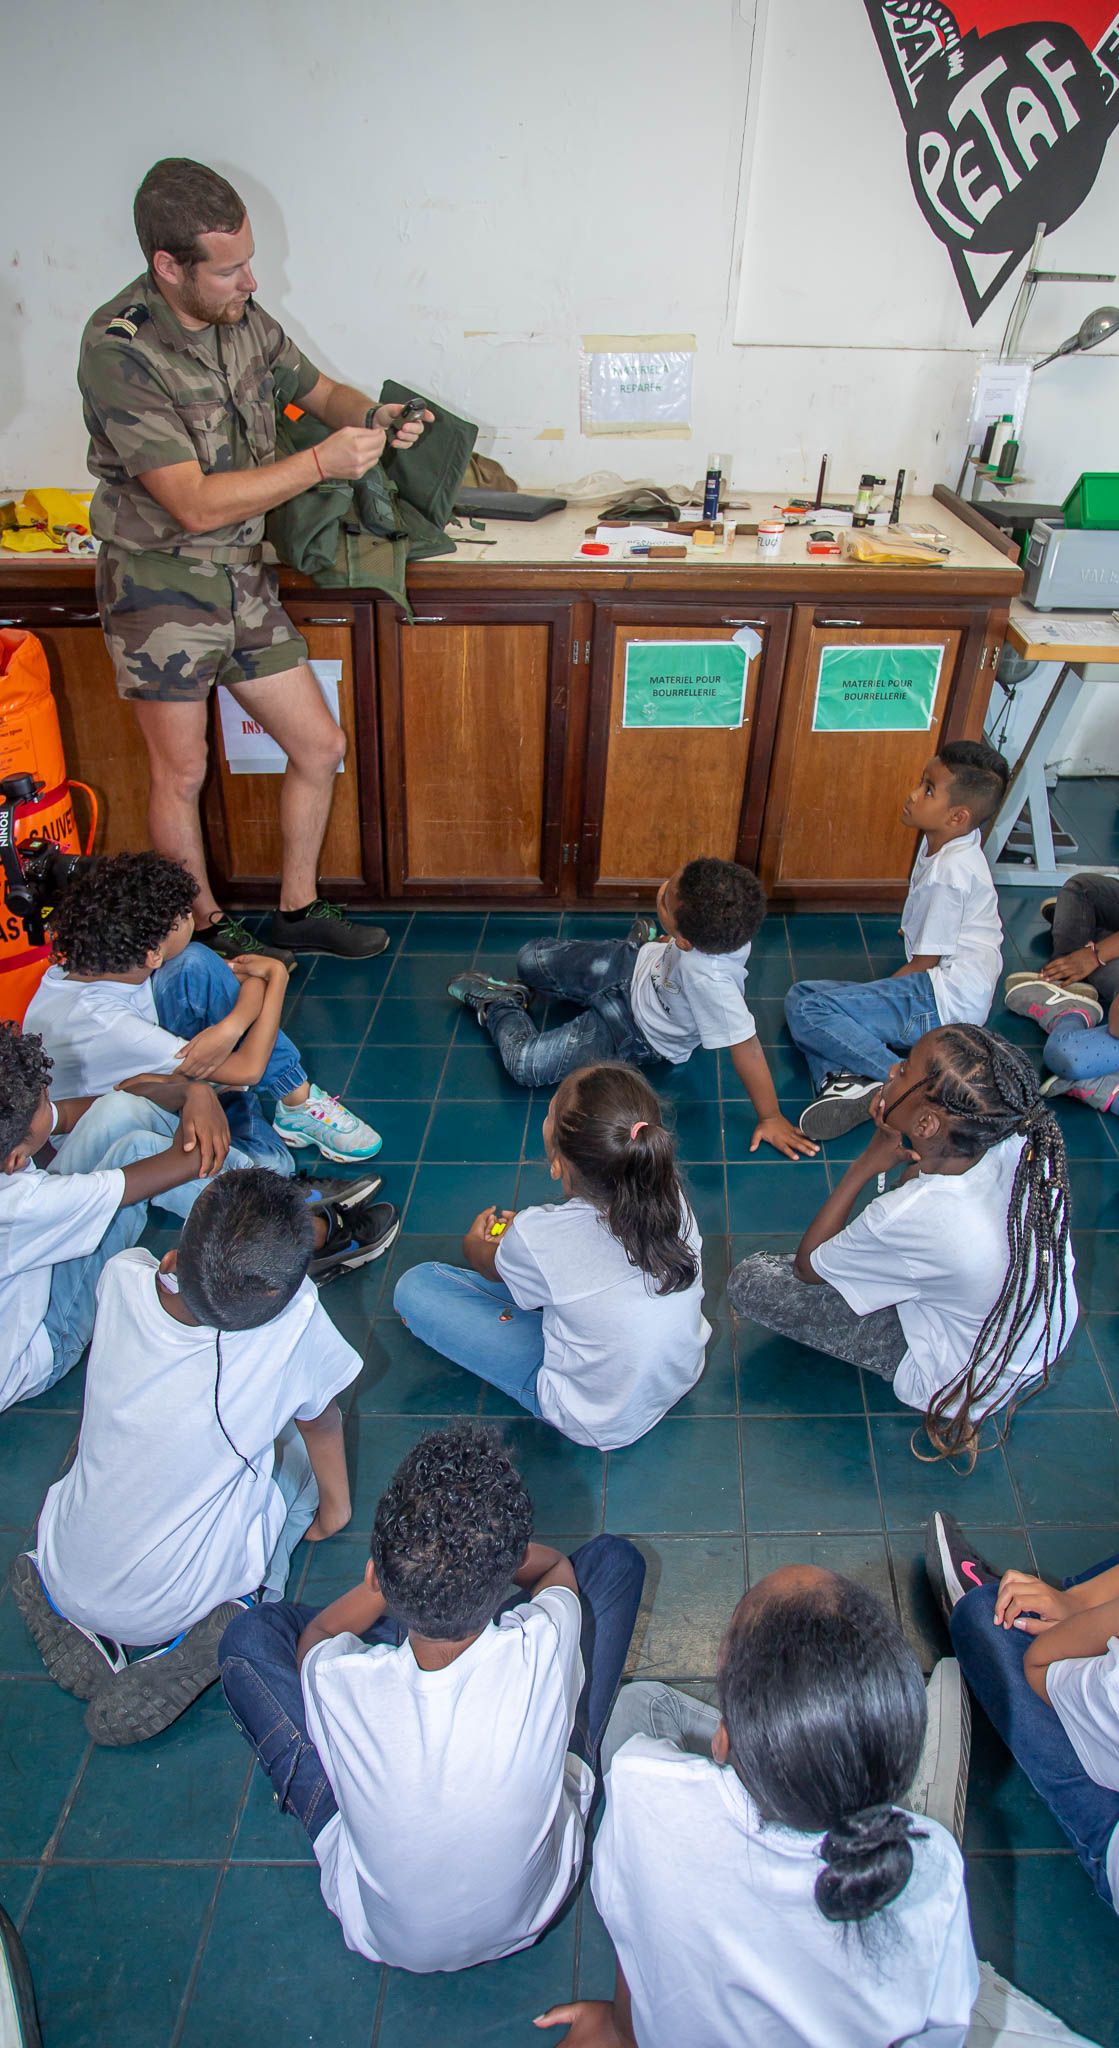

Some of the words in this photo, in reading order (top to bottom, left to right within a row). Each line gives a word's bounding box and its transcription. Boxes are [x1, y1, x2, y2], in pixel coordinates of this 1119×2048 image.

[918, 38, 1081, 240] PETAF
[650, 676, 693, 684] MATERIEL
[842, 680, 885, 688] MATERIEL
[652, 688, 716, 696] BOURRELLERIE
[844, 692, 907, 700] BOURRELLERIE
[0, 811, 9, 847] RONIN
